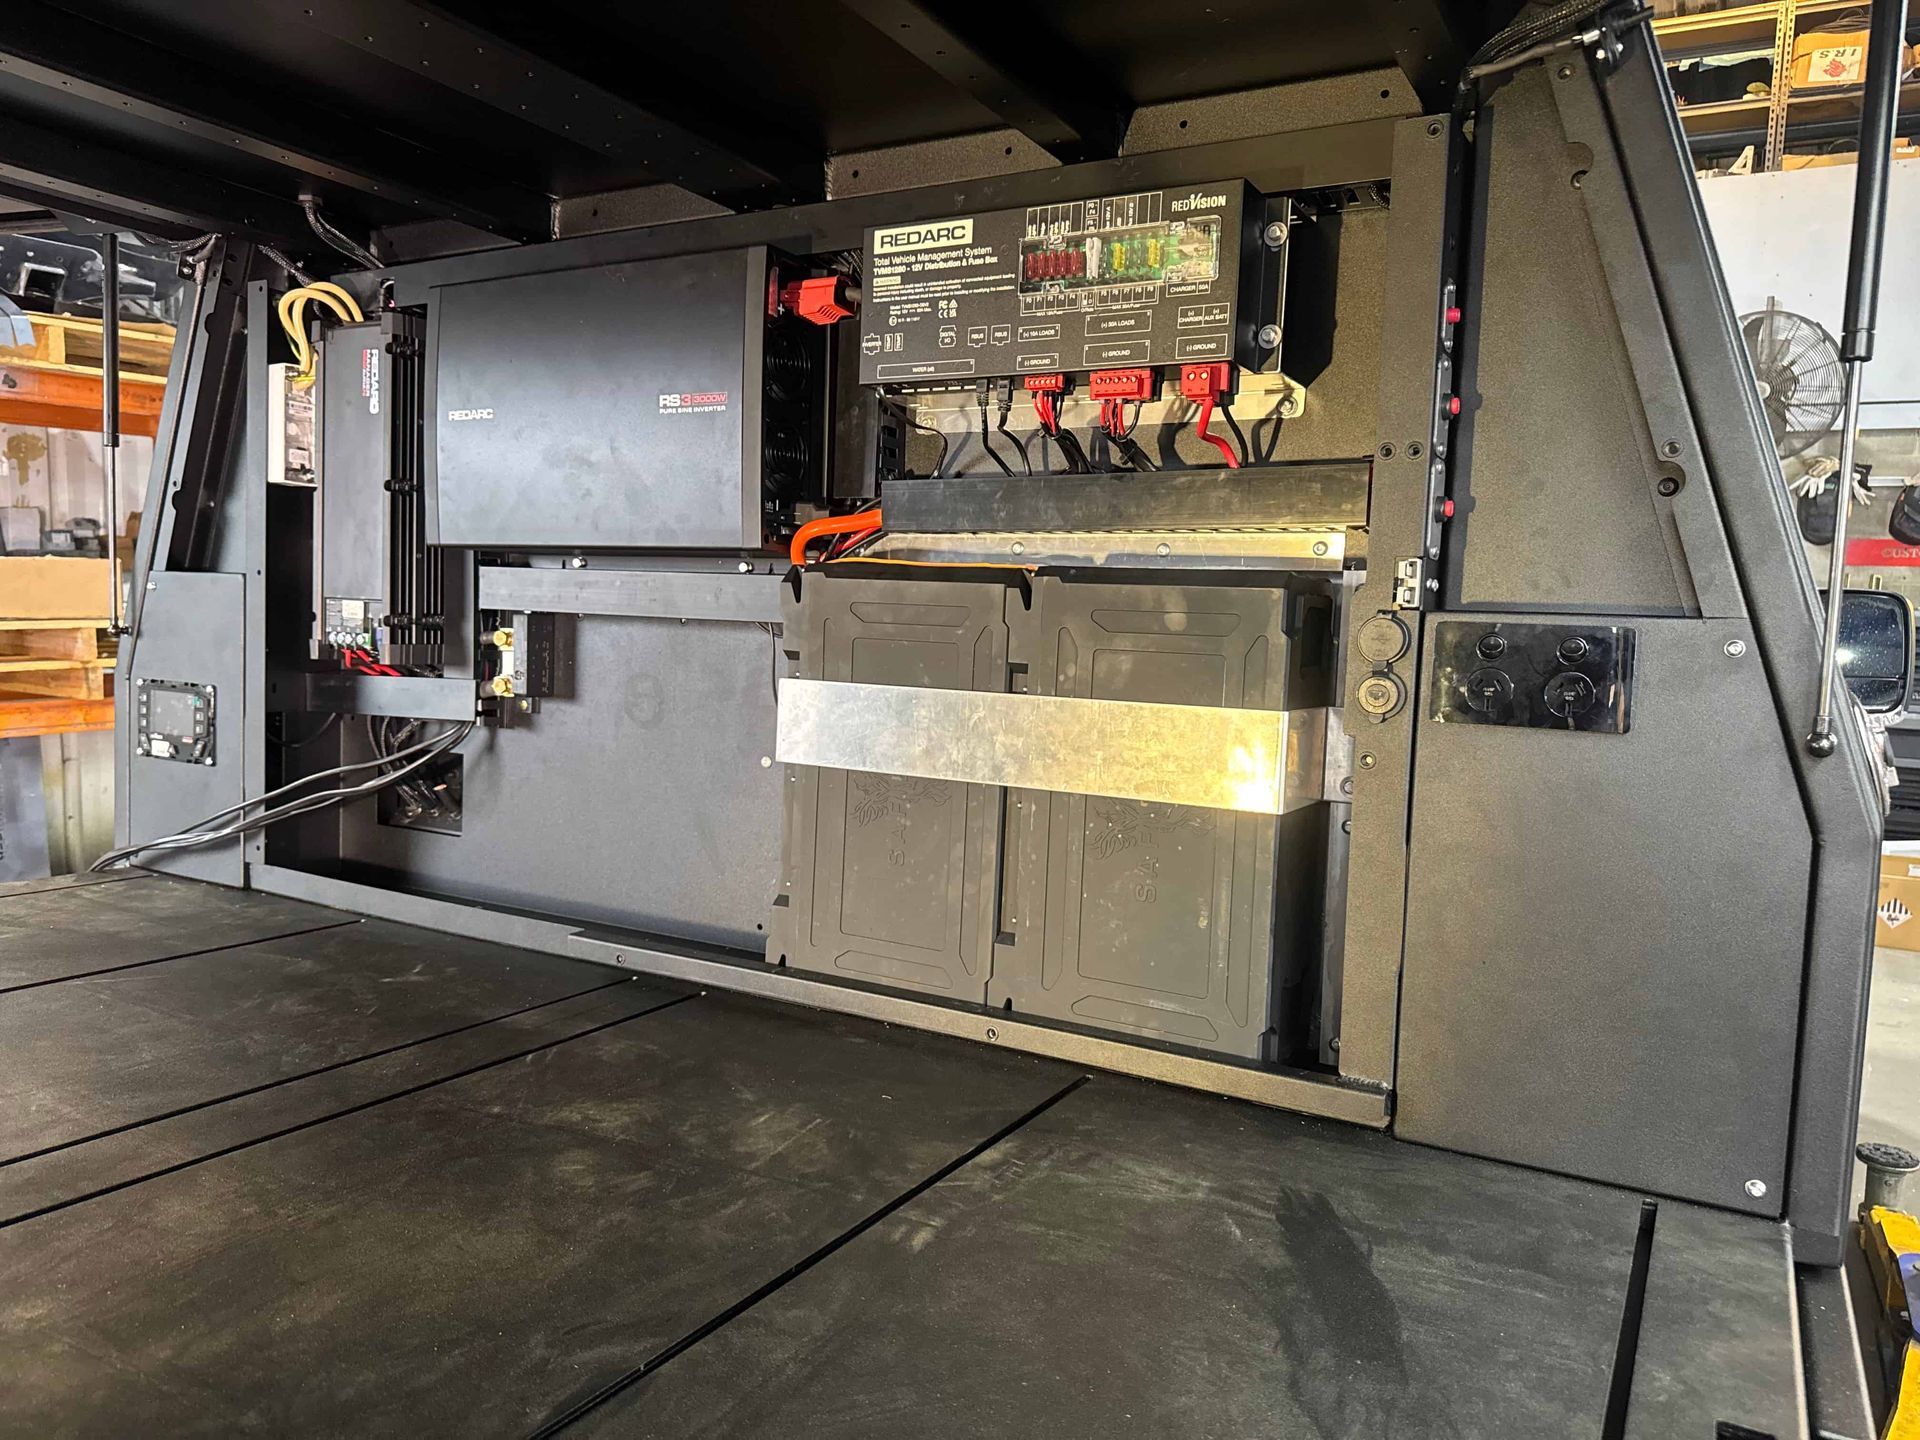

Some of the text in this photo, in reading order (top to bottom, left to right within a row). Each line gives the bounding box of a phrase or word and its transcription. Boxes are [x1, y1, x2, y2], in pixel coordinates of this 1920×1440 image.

[880, 225, 966, 249] REDARC
[873, 247, 992, 266] Total Vehicle Management System
[911, 264, 923, 272] 12V
[924, 259, 960, 271] Distribution
[968, 257, 984, 265] Fuse
[985, 255, 998, 263] Box
[1170, 285, 1195, 293] CHARGER
[693, 394, 725, 403] 3000W
[448, 408, 494, 421] REDARC
[1880, 648, 1920, 658] CUST
